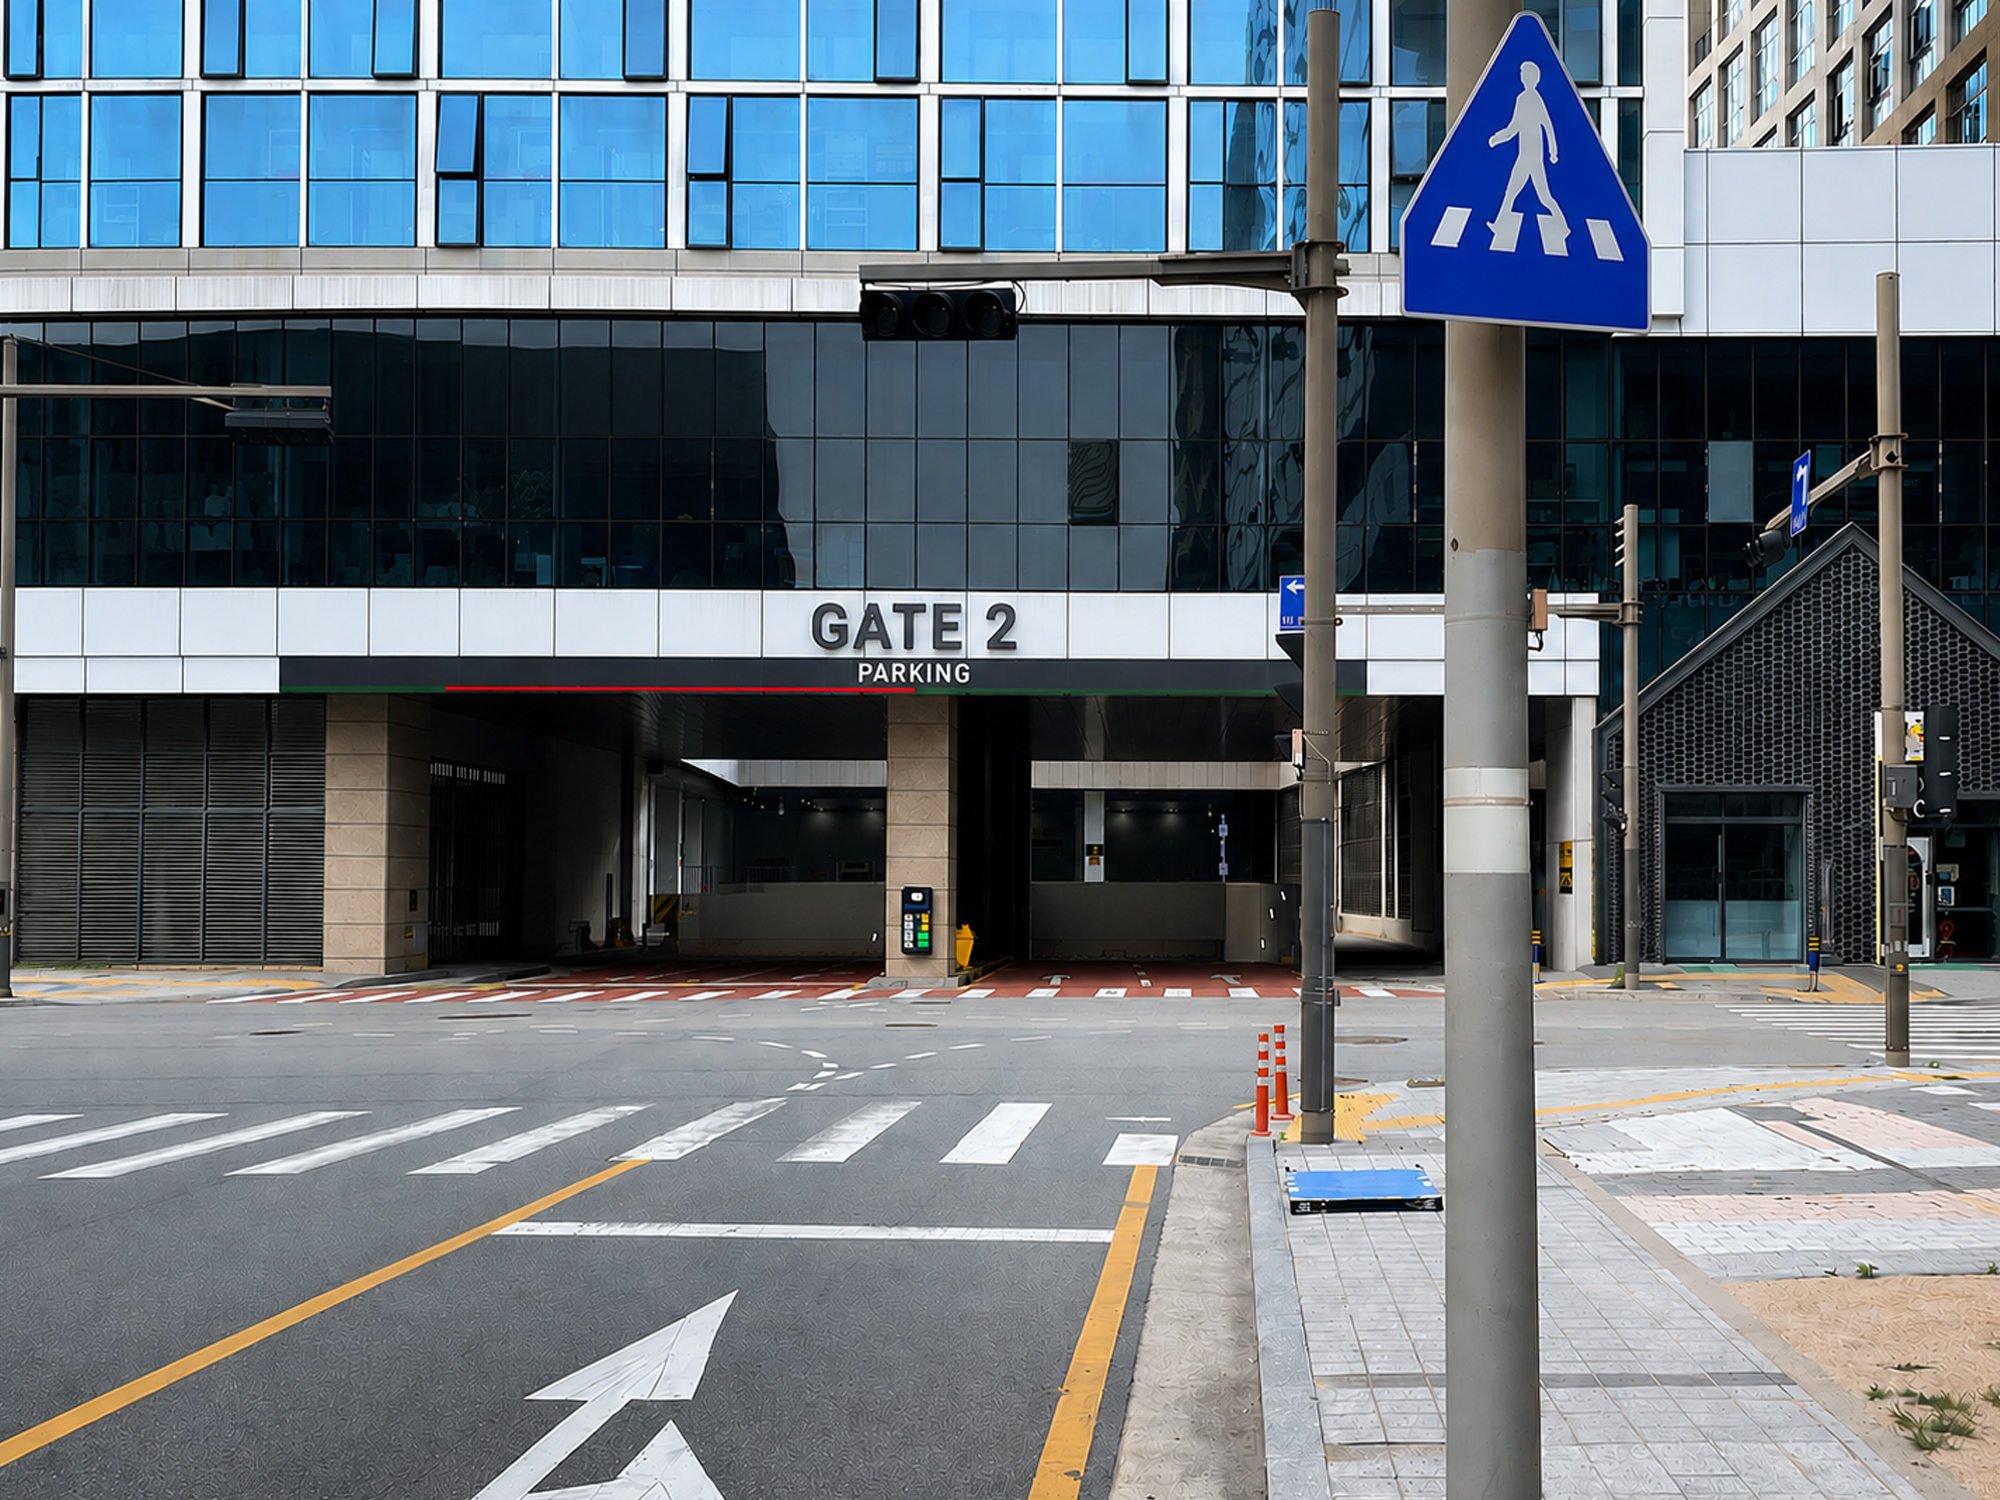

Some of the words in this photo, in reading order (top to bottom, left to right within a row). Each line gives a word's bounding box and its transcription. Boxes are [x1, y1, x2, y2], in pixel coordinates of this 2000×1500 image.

[812, 602, 962, 651] GATE
[986, 602, 1017, 650] 2
[858, 662, 971, 683] PARKING
